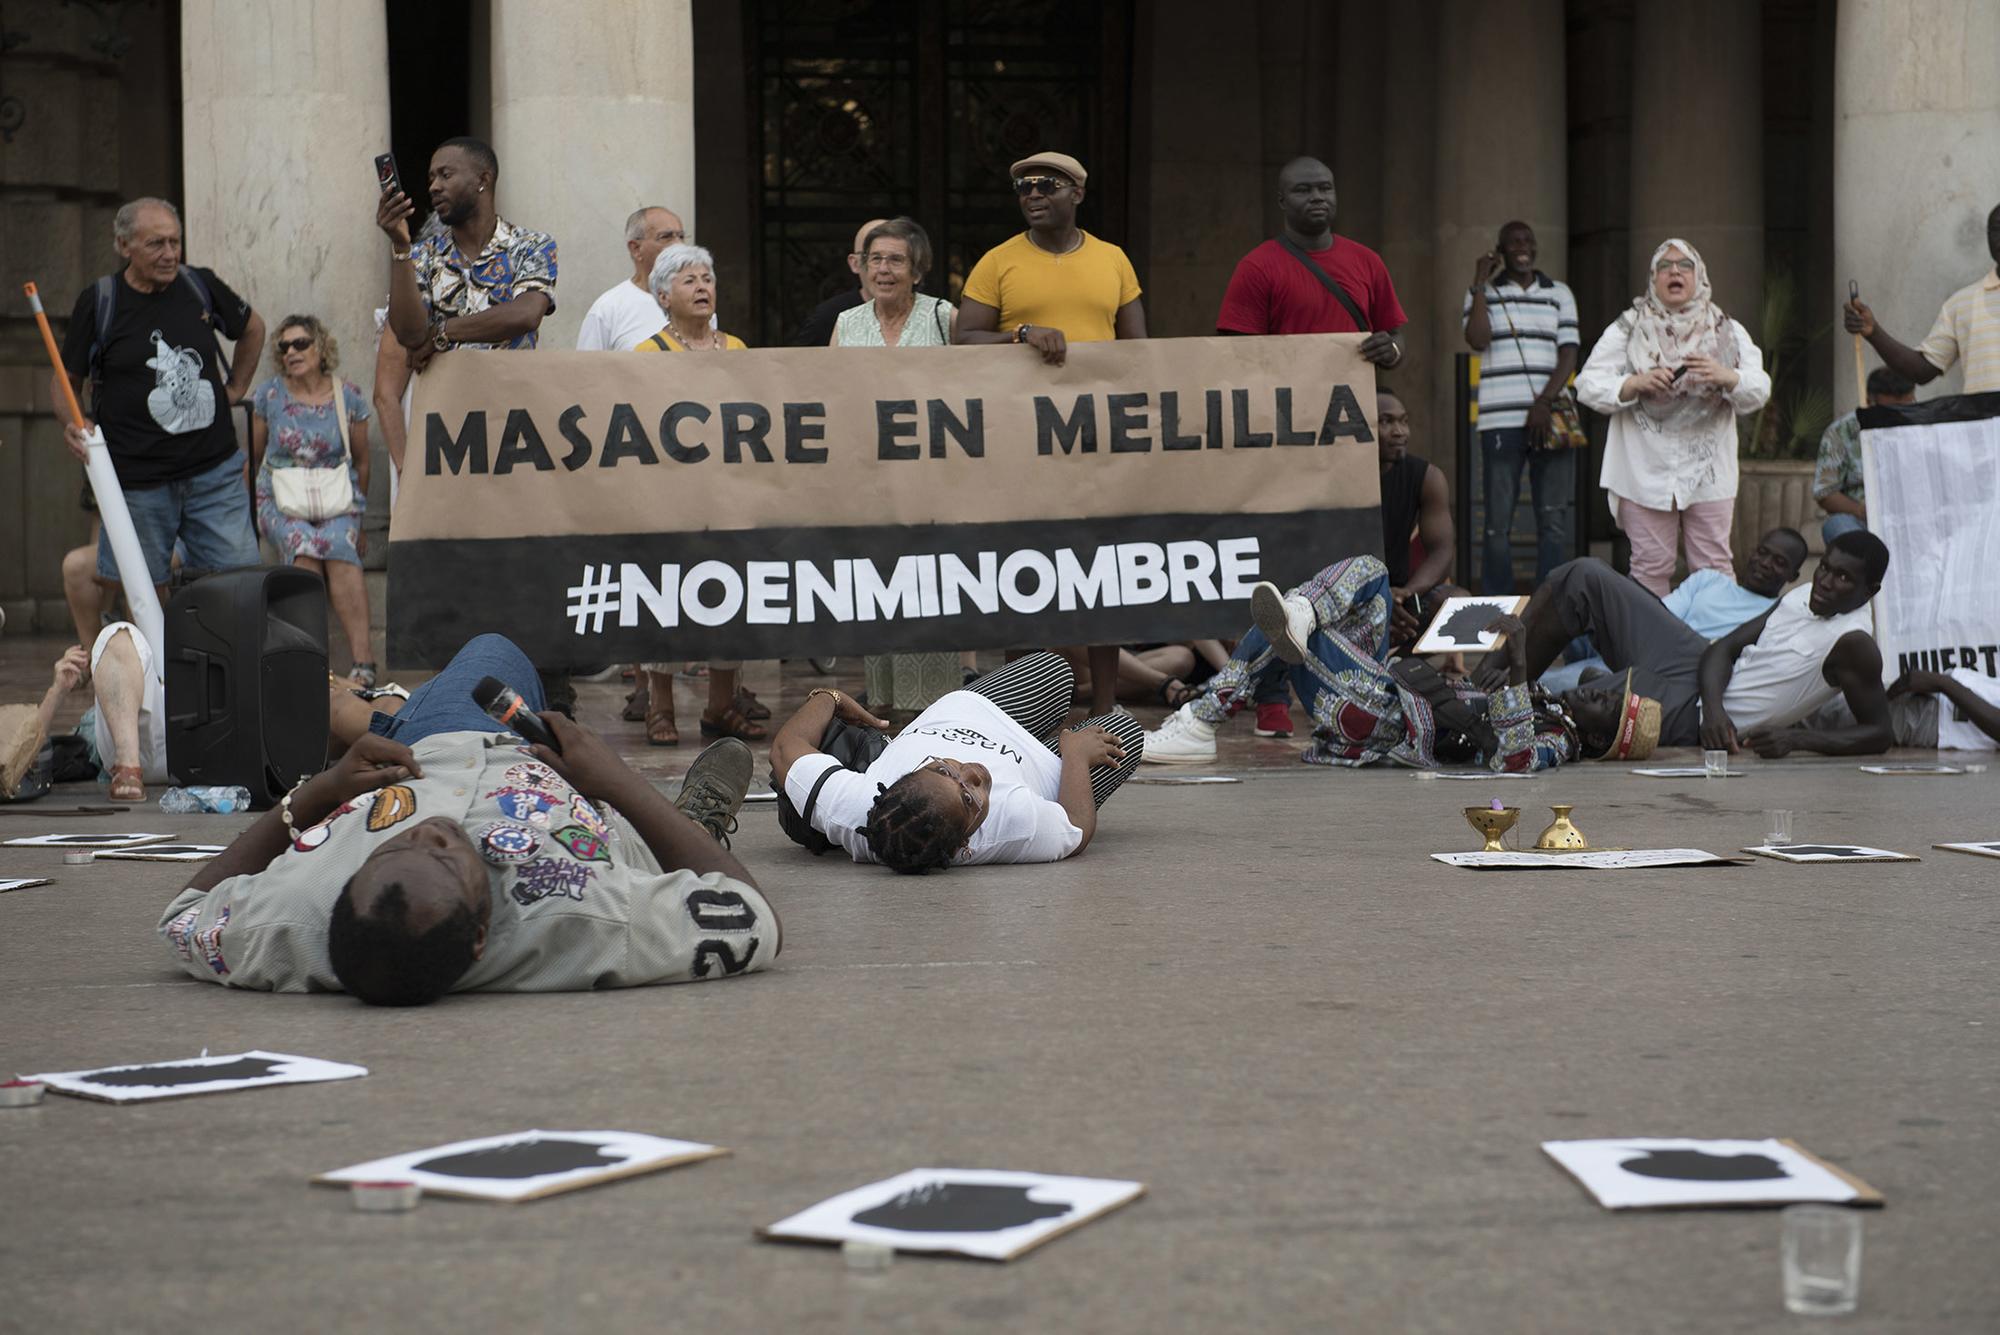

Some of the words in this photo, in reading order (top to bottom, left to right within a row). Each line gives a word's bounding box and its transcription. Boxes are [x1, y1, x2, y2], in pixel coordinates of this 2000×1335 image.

[425, 401, 829, 475] MASACRE
[876, 398, 985, 460] EN
[1033, 385, 1375, 456] MELILLA
[567, 537, 1261, 635] #NOENMINOMBRE
[1899, 645, 2000, 678] MUERT
[899, 728, 1022, 764] Masacr
[683, 889, 760, 977] 20
